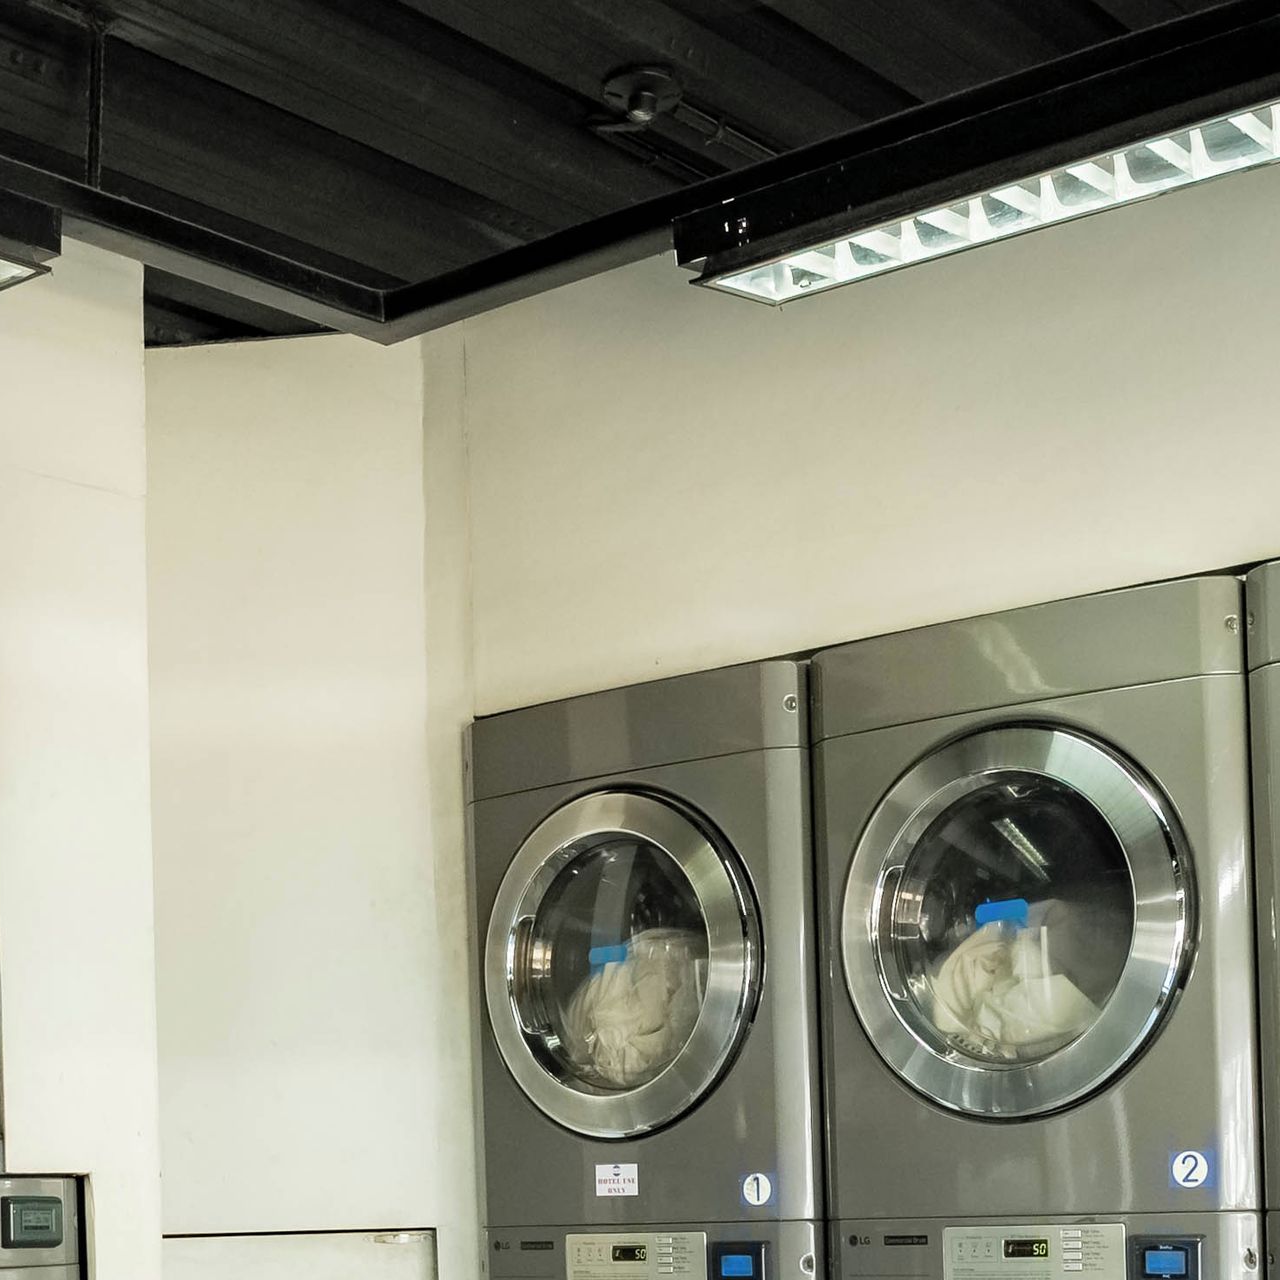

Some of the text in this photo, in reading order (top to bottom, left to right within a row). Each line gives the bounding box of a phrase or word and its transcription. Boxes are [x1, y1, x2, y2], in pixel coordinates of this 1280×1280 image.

[1182, 1155, 1199, 1184] 2
[859, 1236, 871, 1246] LG
[634, 1249, 646, 1259] 50
[1033, 1243, 1047, 1255] 50
